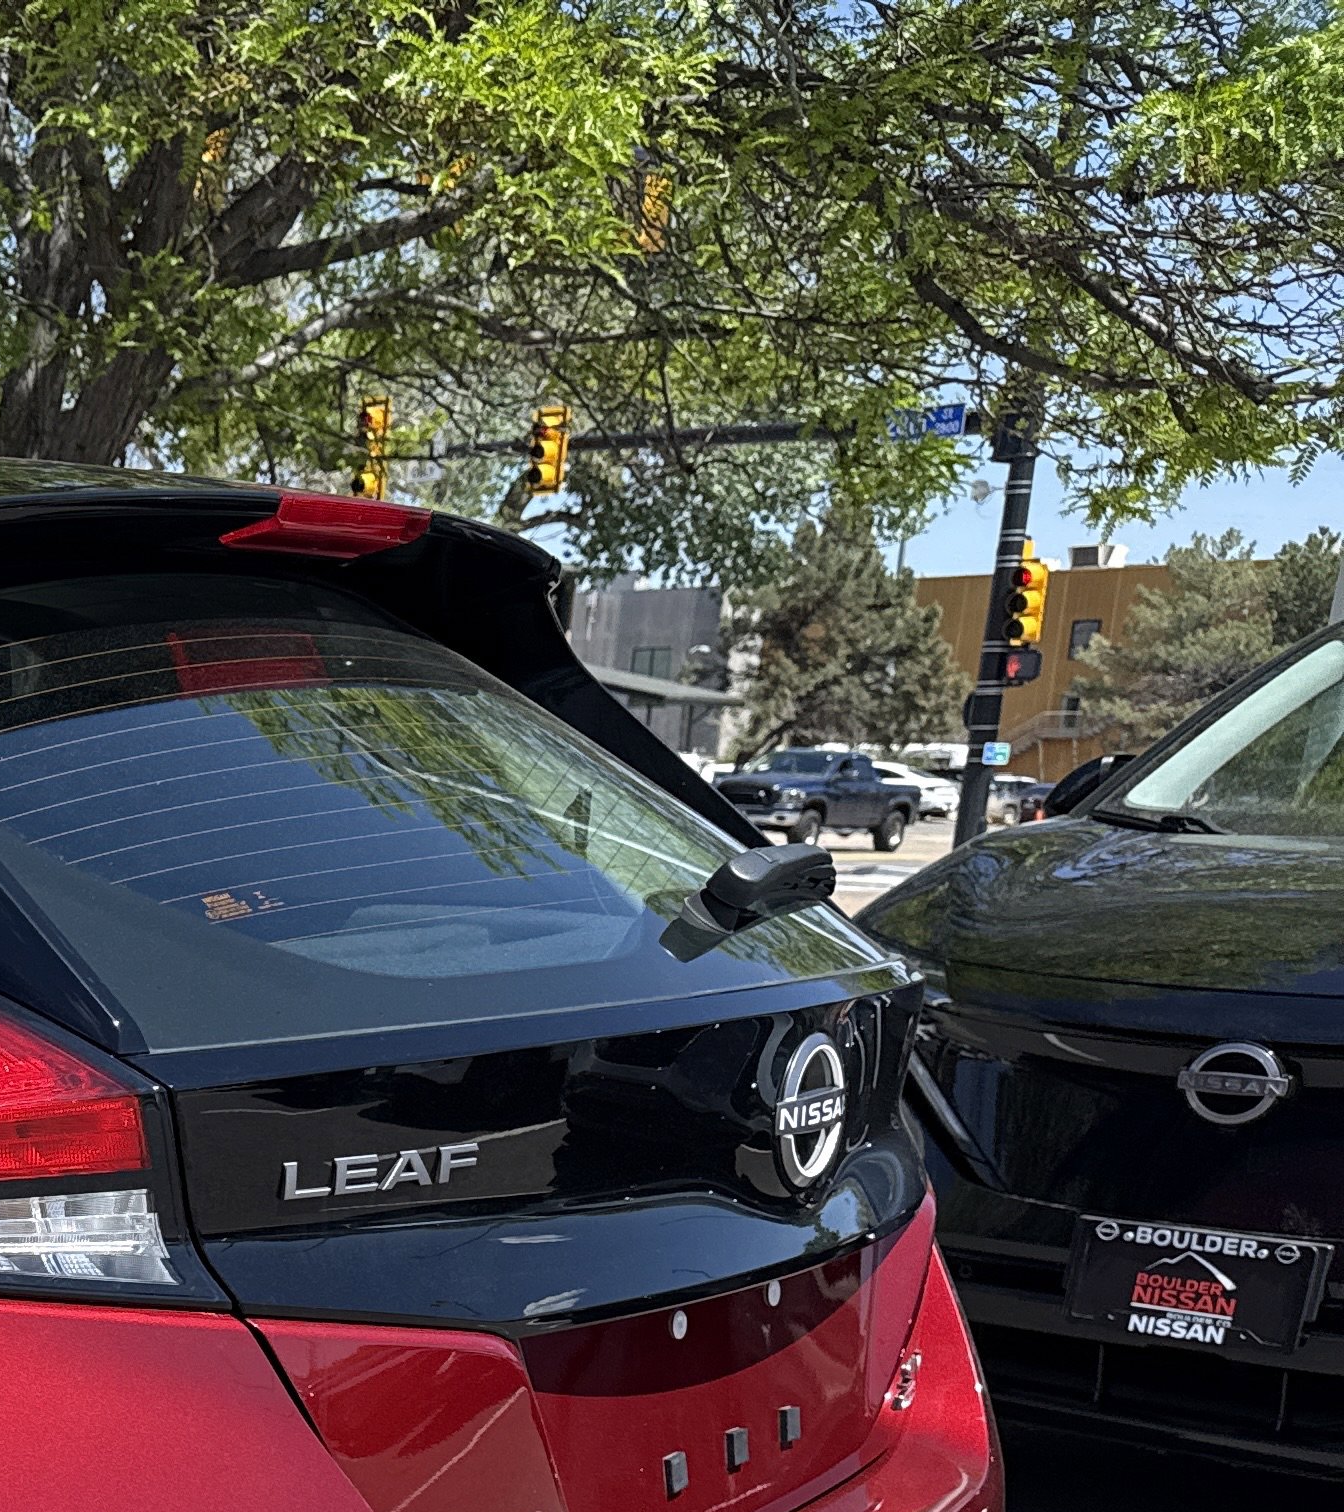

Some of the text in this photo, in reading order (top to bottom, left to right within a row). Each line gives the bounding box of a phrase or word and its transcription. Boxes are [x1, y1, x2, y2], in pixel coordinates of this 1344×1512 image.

[1179, 1072, 1286, 1097] NISSAN
[280, 1142, 480, 1201] LEAF
[1135, 1225, 1258, 1259] BOULDER
[1135, 1271, 1224, 1297] BOULDER
[1130, 1284, 1237, 1317] NISSAN
[1127, 1313, 1226, 1345] NISSAN
